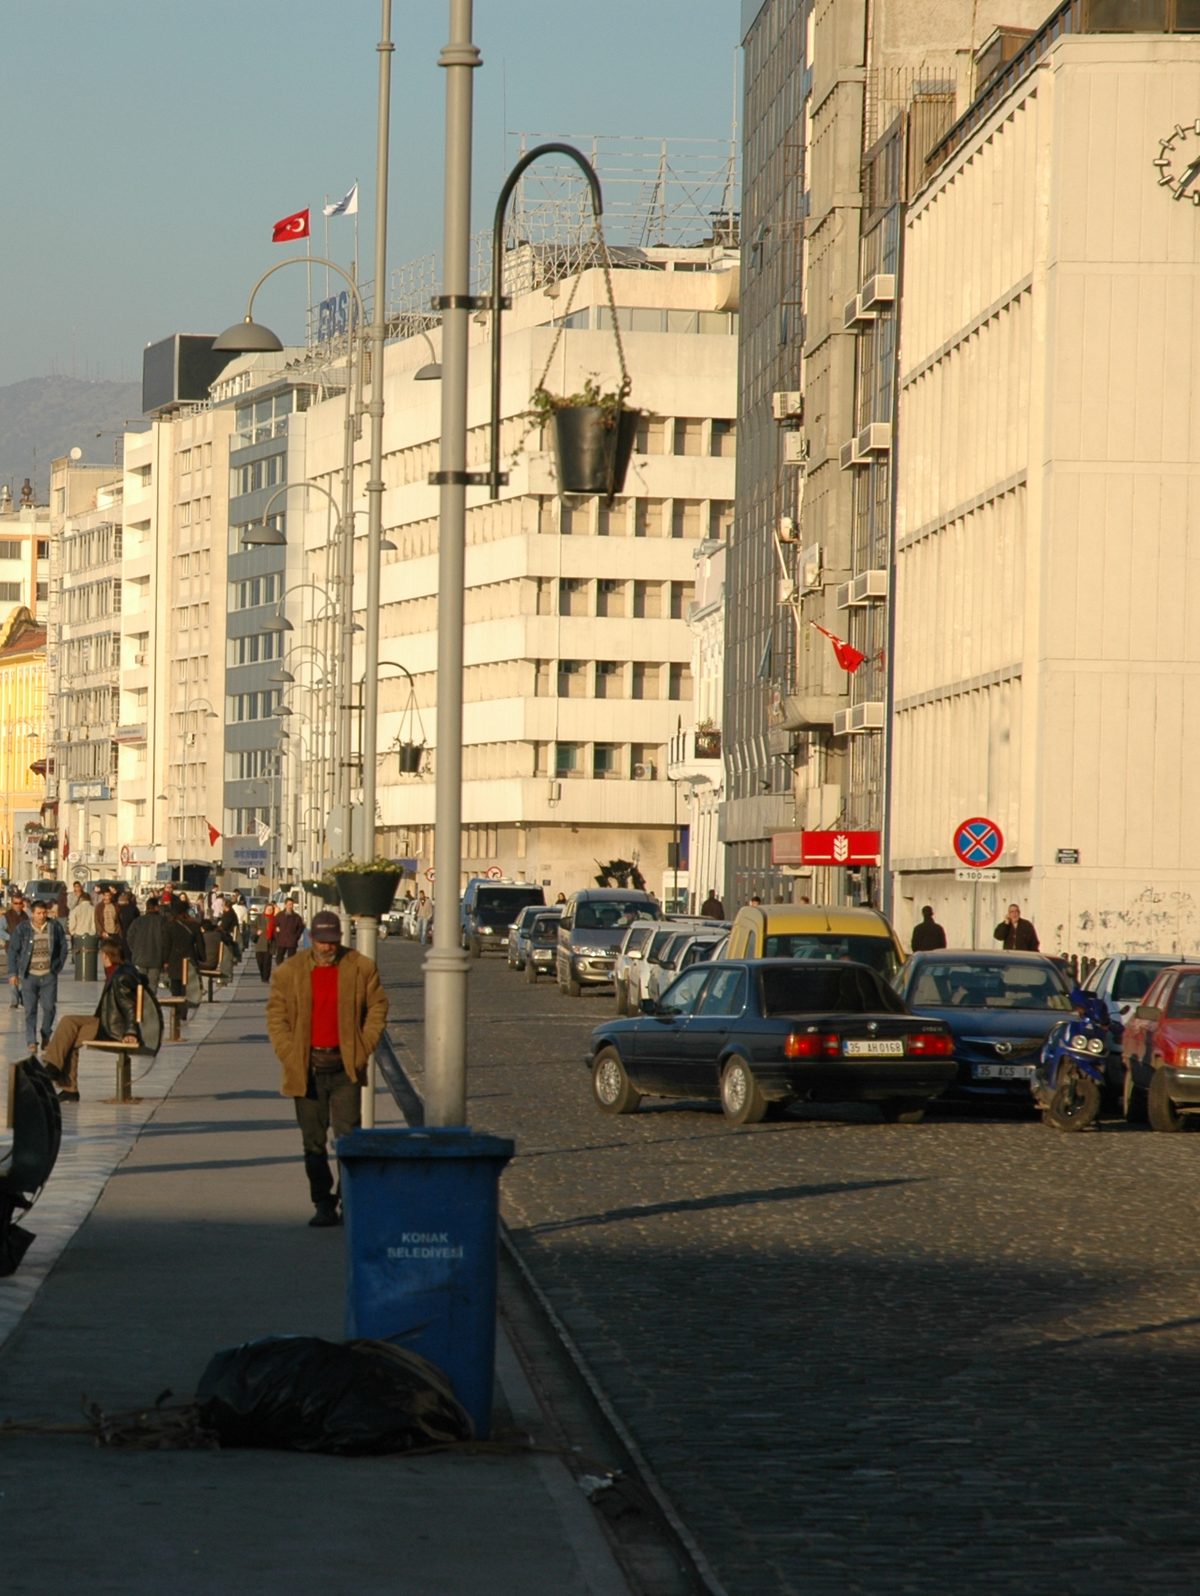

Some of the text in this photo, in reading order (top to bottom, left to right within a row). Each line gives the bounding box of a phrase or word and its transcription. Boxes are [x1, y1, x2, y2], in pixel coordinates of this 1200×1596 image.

[849, 1043, 860, 1052] 35
[402, 1233, 448, 1243] KONAK
[387, 1246, 463, 1259] BELEDİYESİ
